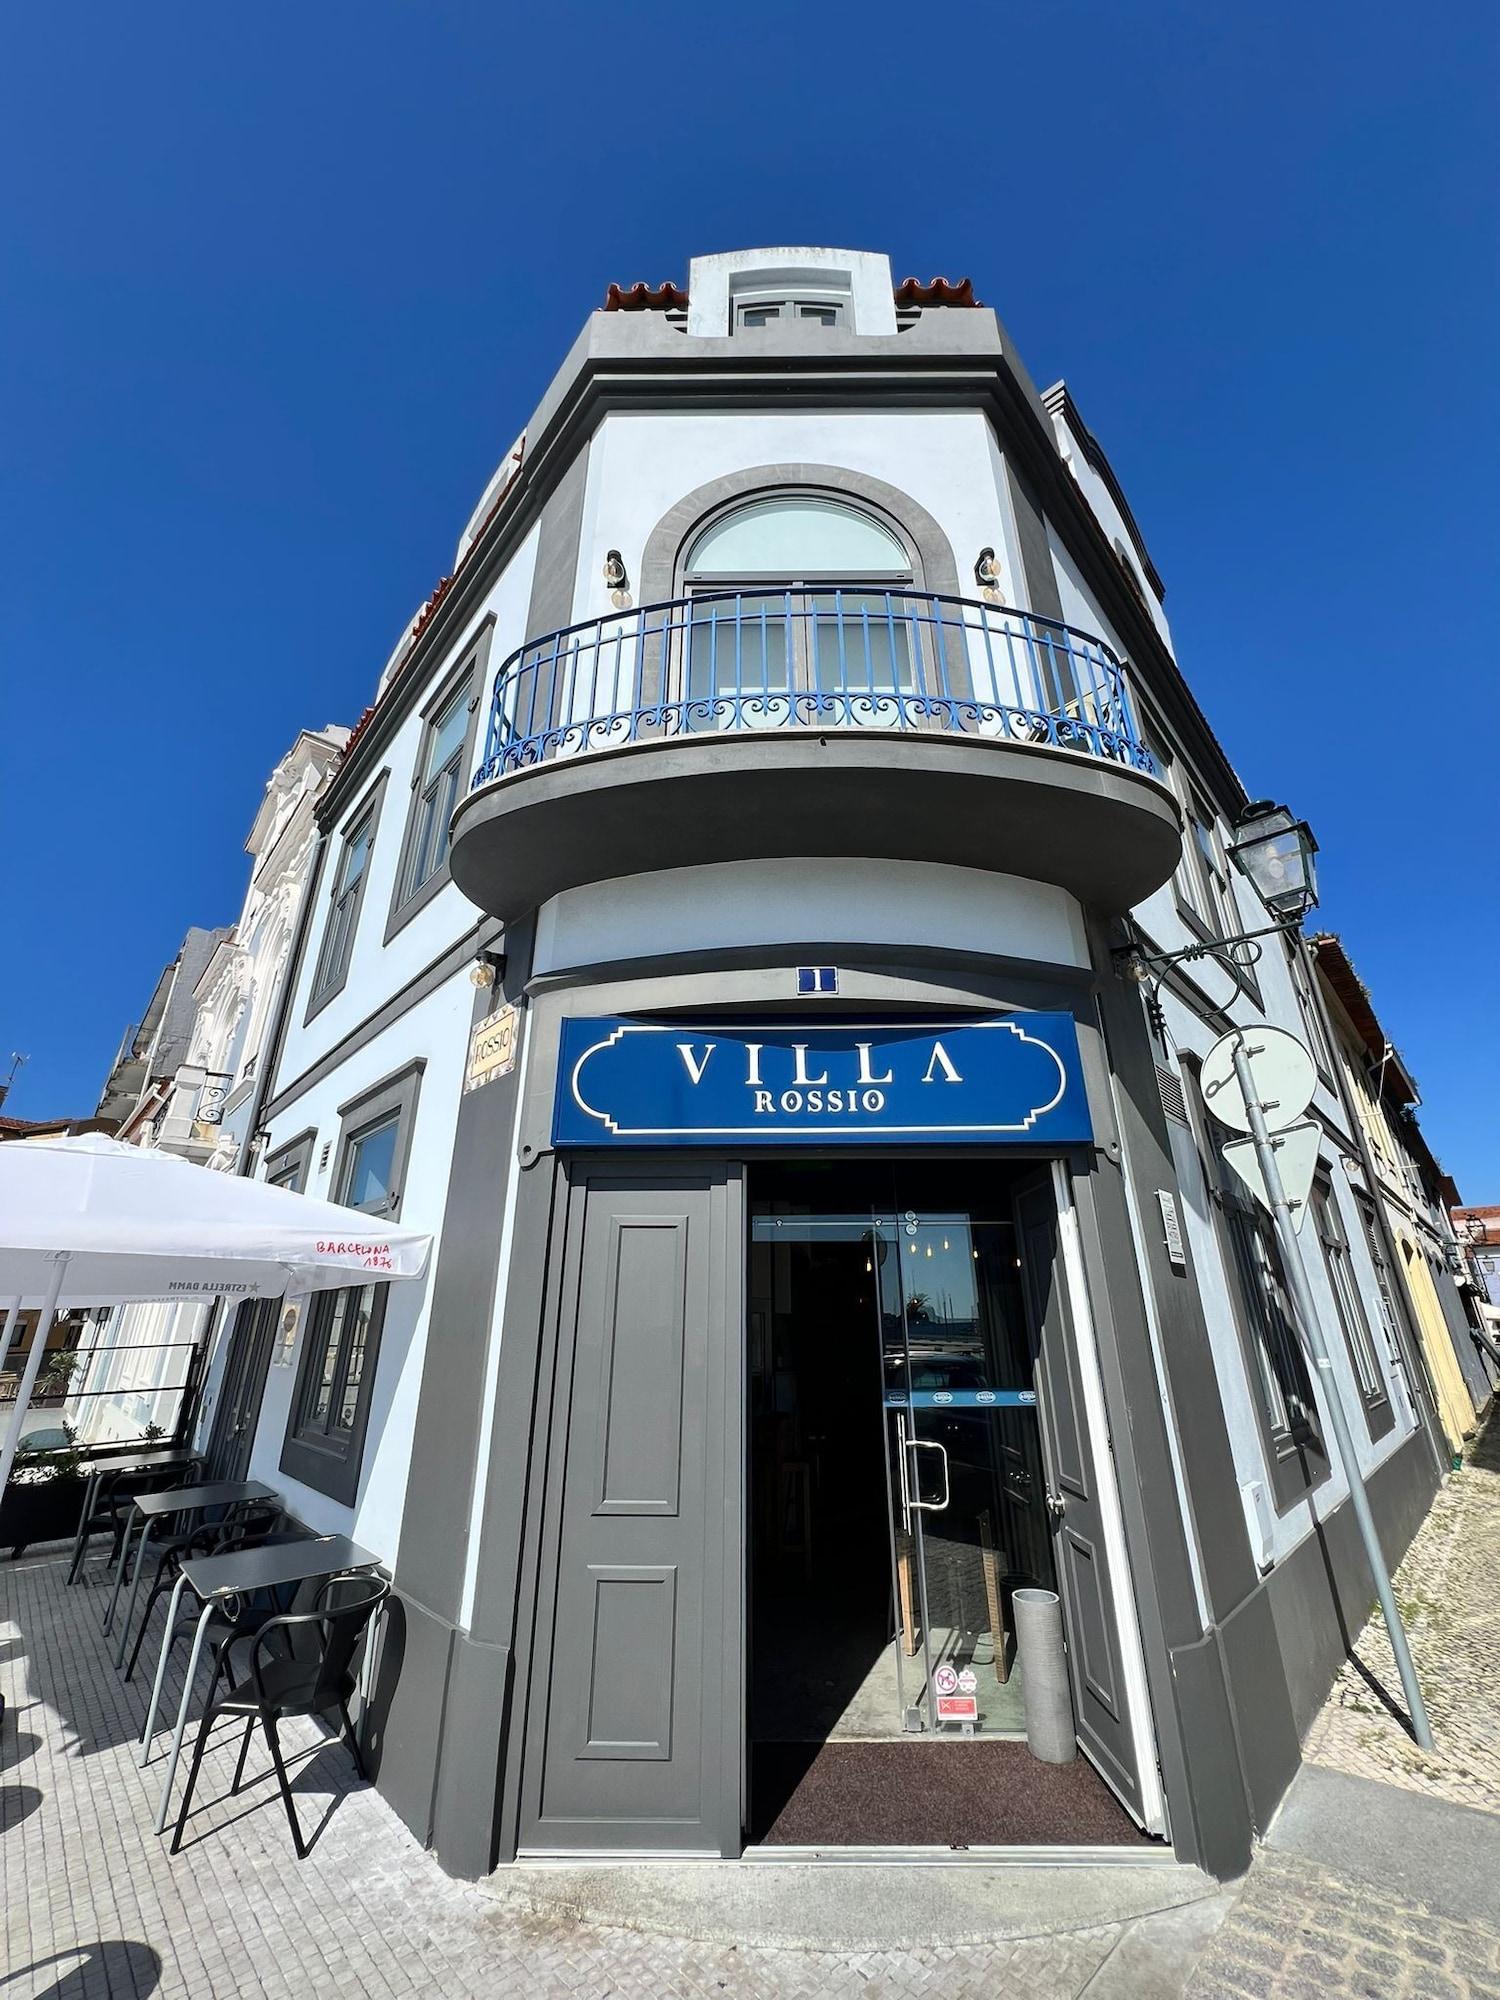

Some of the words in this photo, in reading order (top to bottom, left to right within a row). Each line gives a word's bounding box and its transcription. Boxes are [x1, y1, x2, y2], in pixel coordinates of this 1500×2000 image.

[812, 968, 823, 991] 1
[676, 1040, 964, 1085] VILLA
[754, 1089, 885, 1113] ROSSIO
[316, 1241, 390, 1256] BARCELONA
